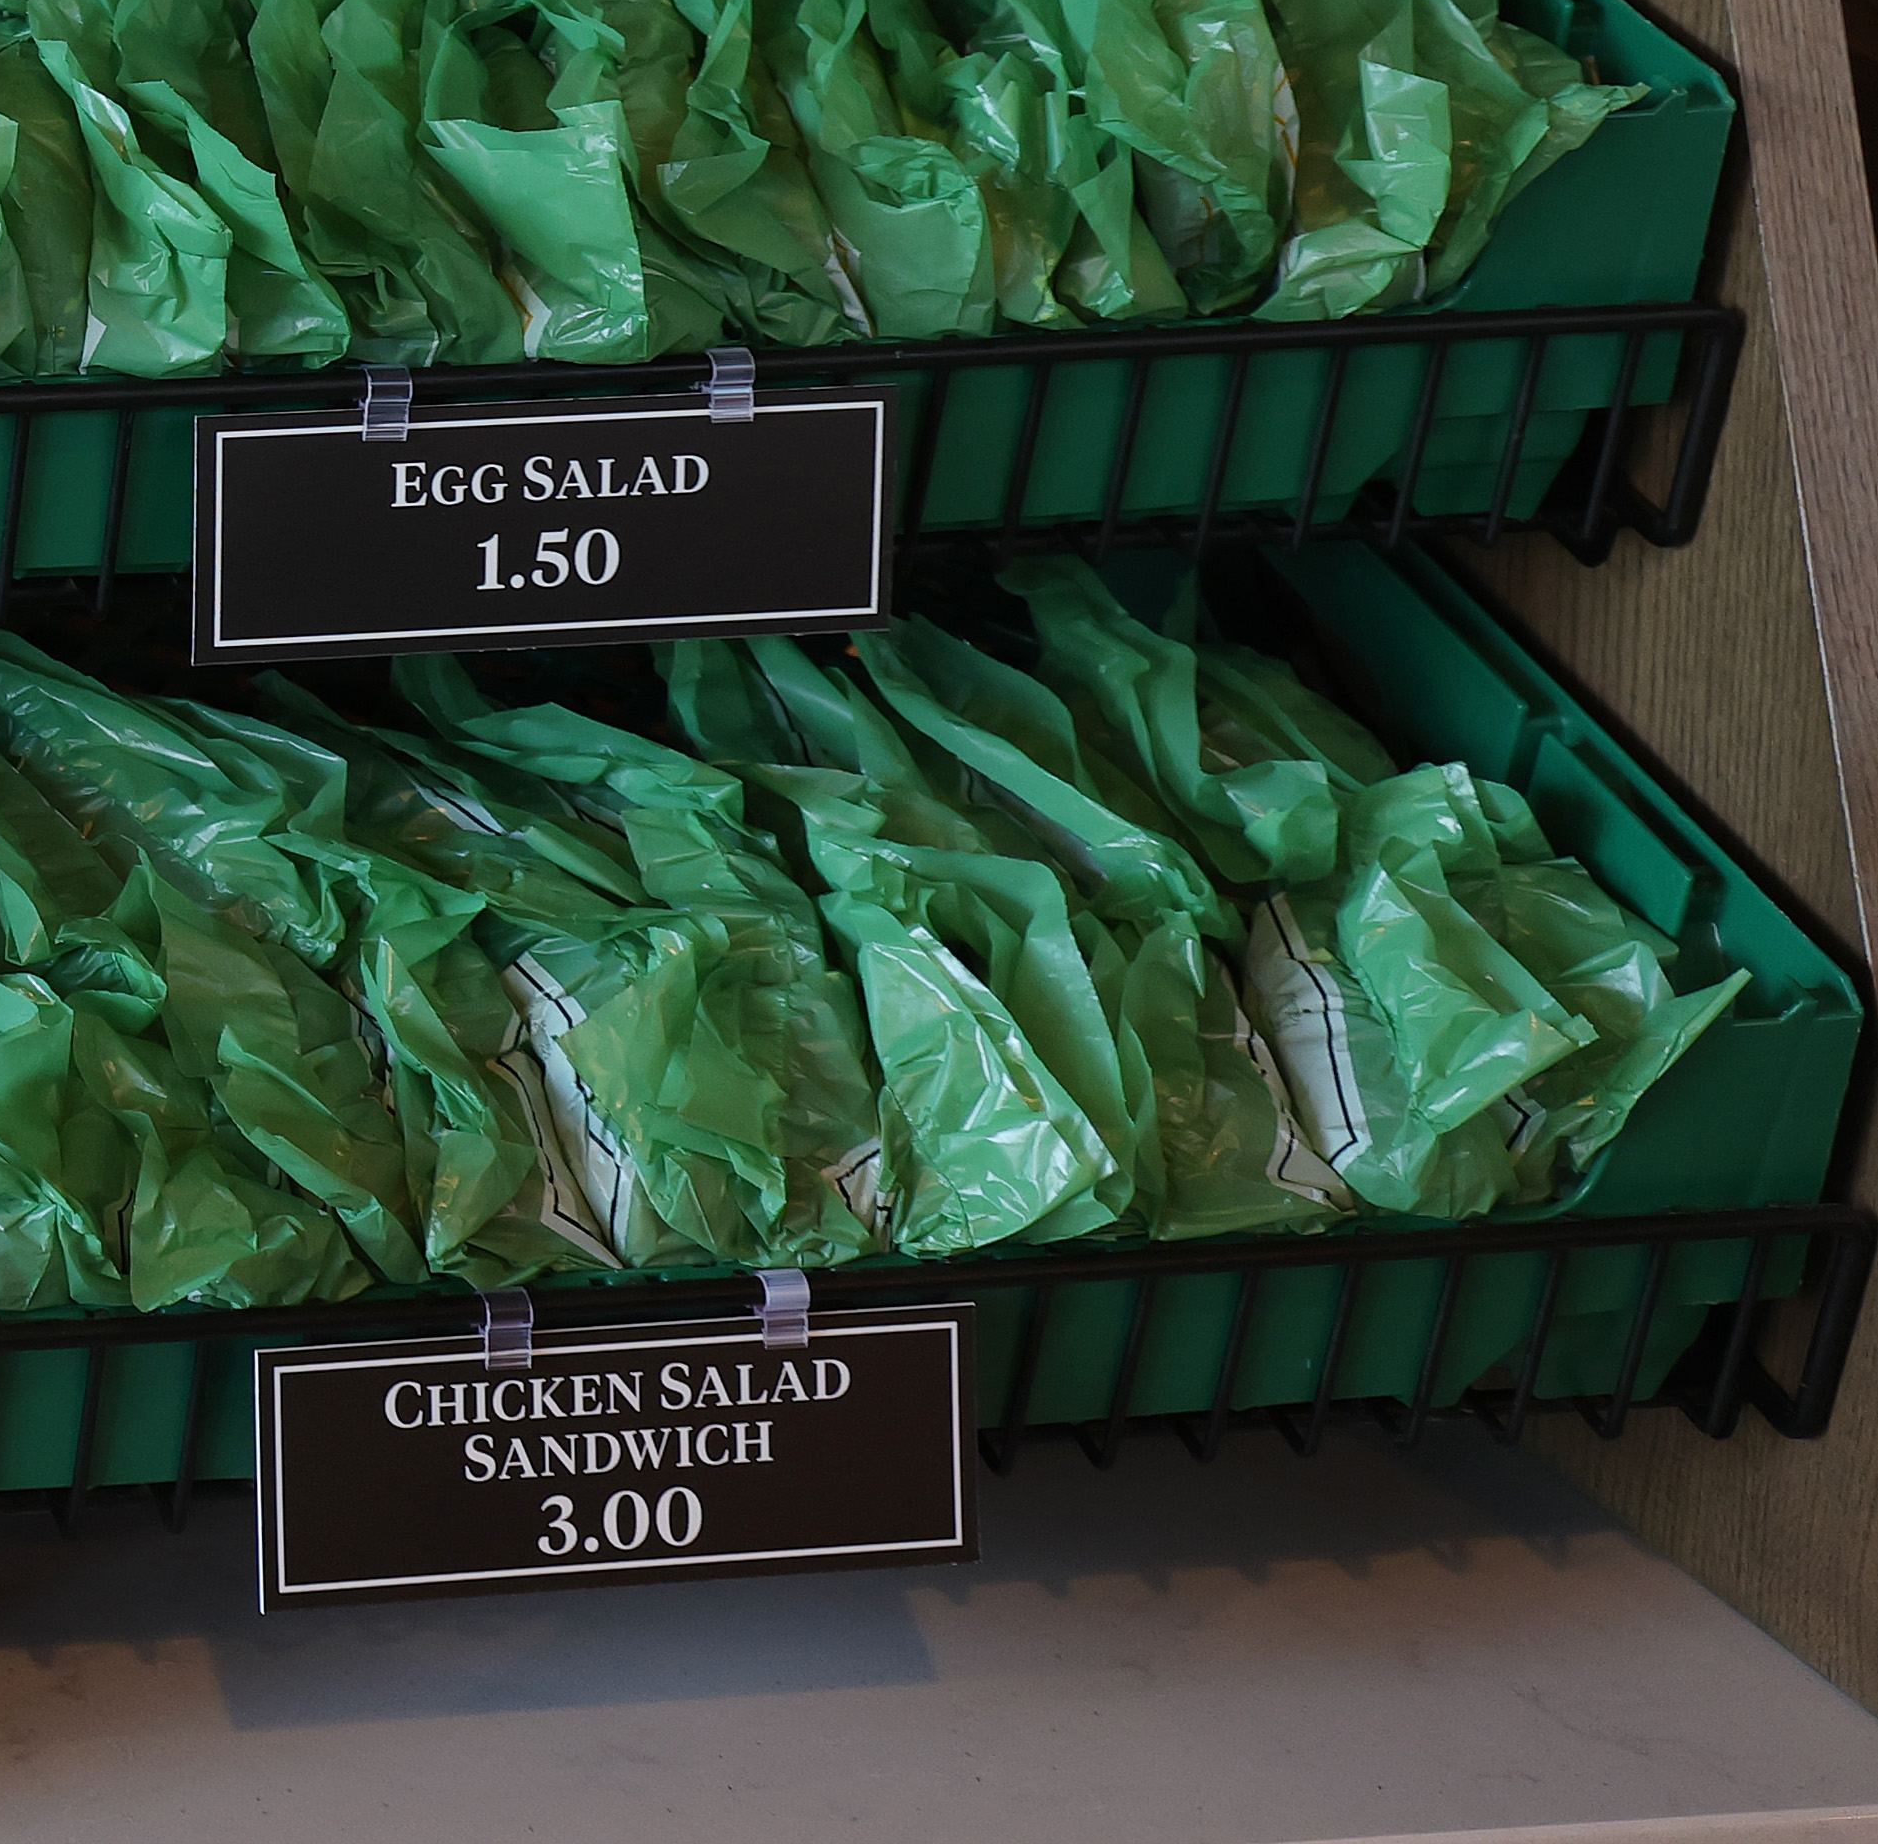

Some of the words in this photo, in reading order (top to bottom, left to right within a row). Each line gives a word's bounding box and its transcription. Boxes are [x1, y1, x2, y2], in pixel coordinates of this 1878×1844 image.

[390, 462, 509, 508] EGG
[523, 455, 709, 501] SALAD
[476, 528, 620, 590] 1.50
[384, 1371, 644, 1429] CHICKEN
[660, 1359, 851, 1410] SALAD
[464, 1421, 774, 1482] SANDWICH
[537, 1486, 702, 1555] 3.00
